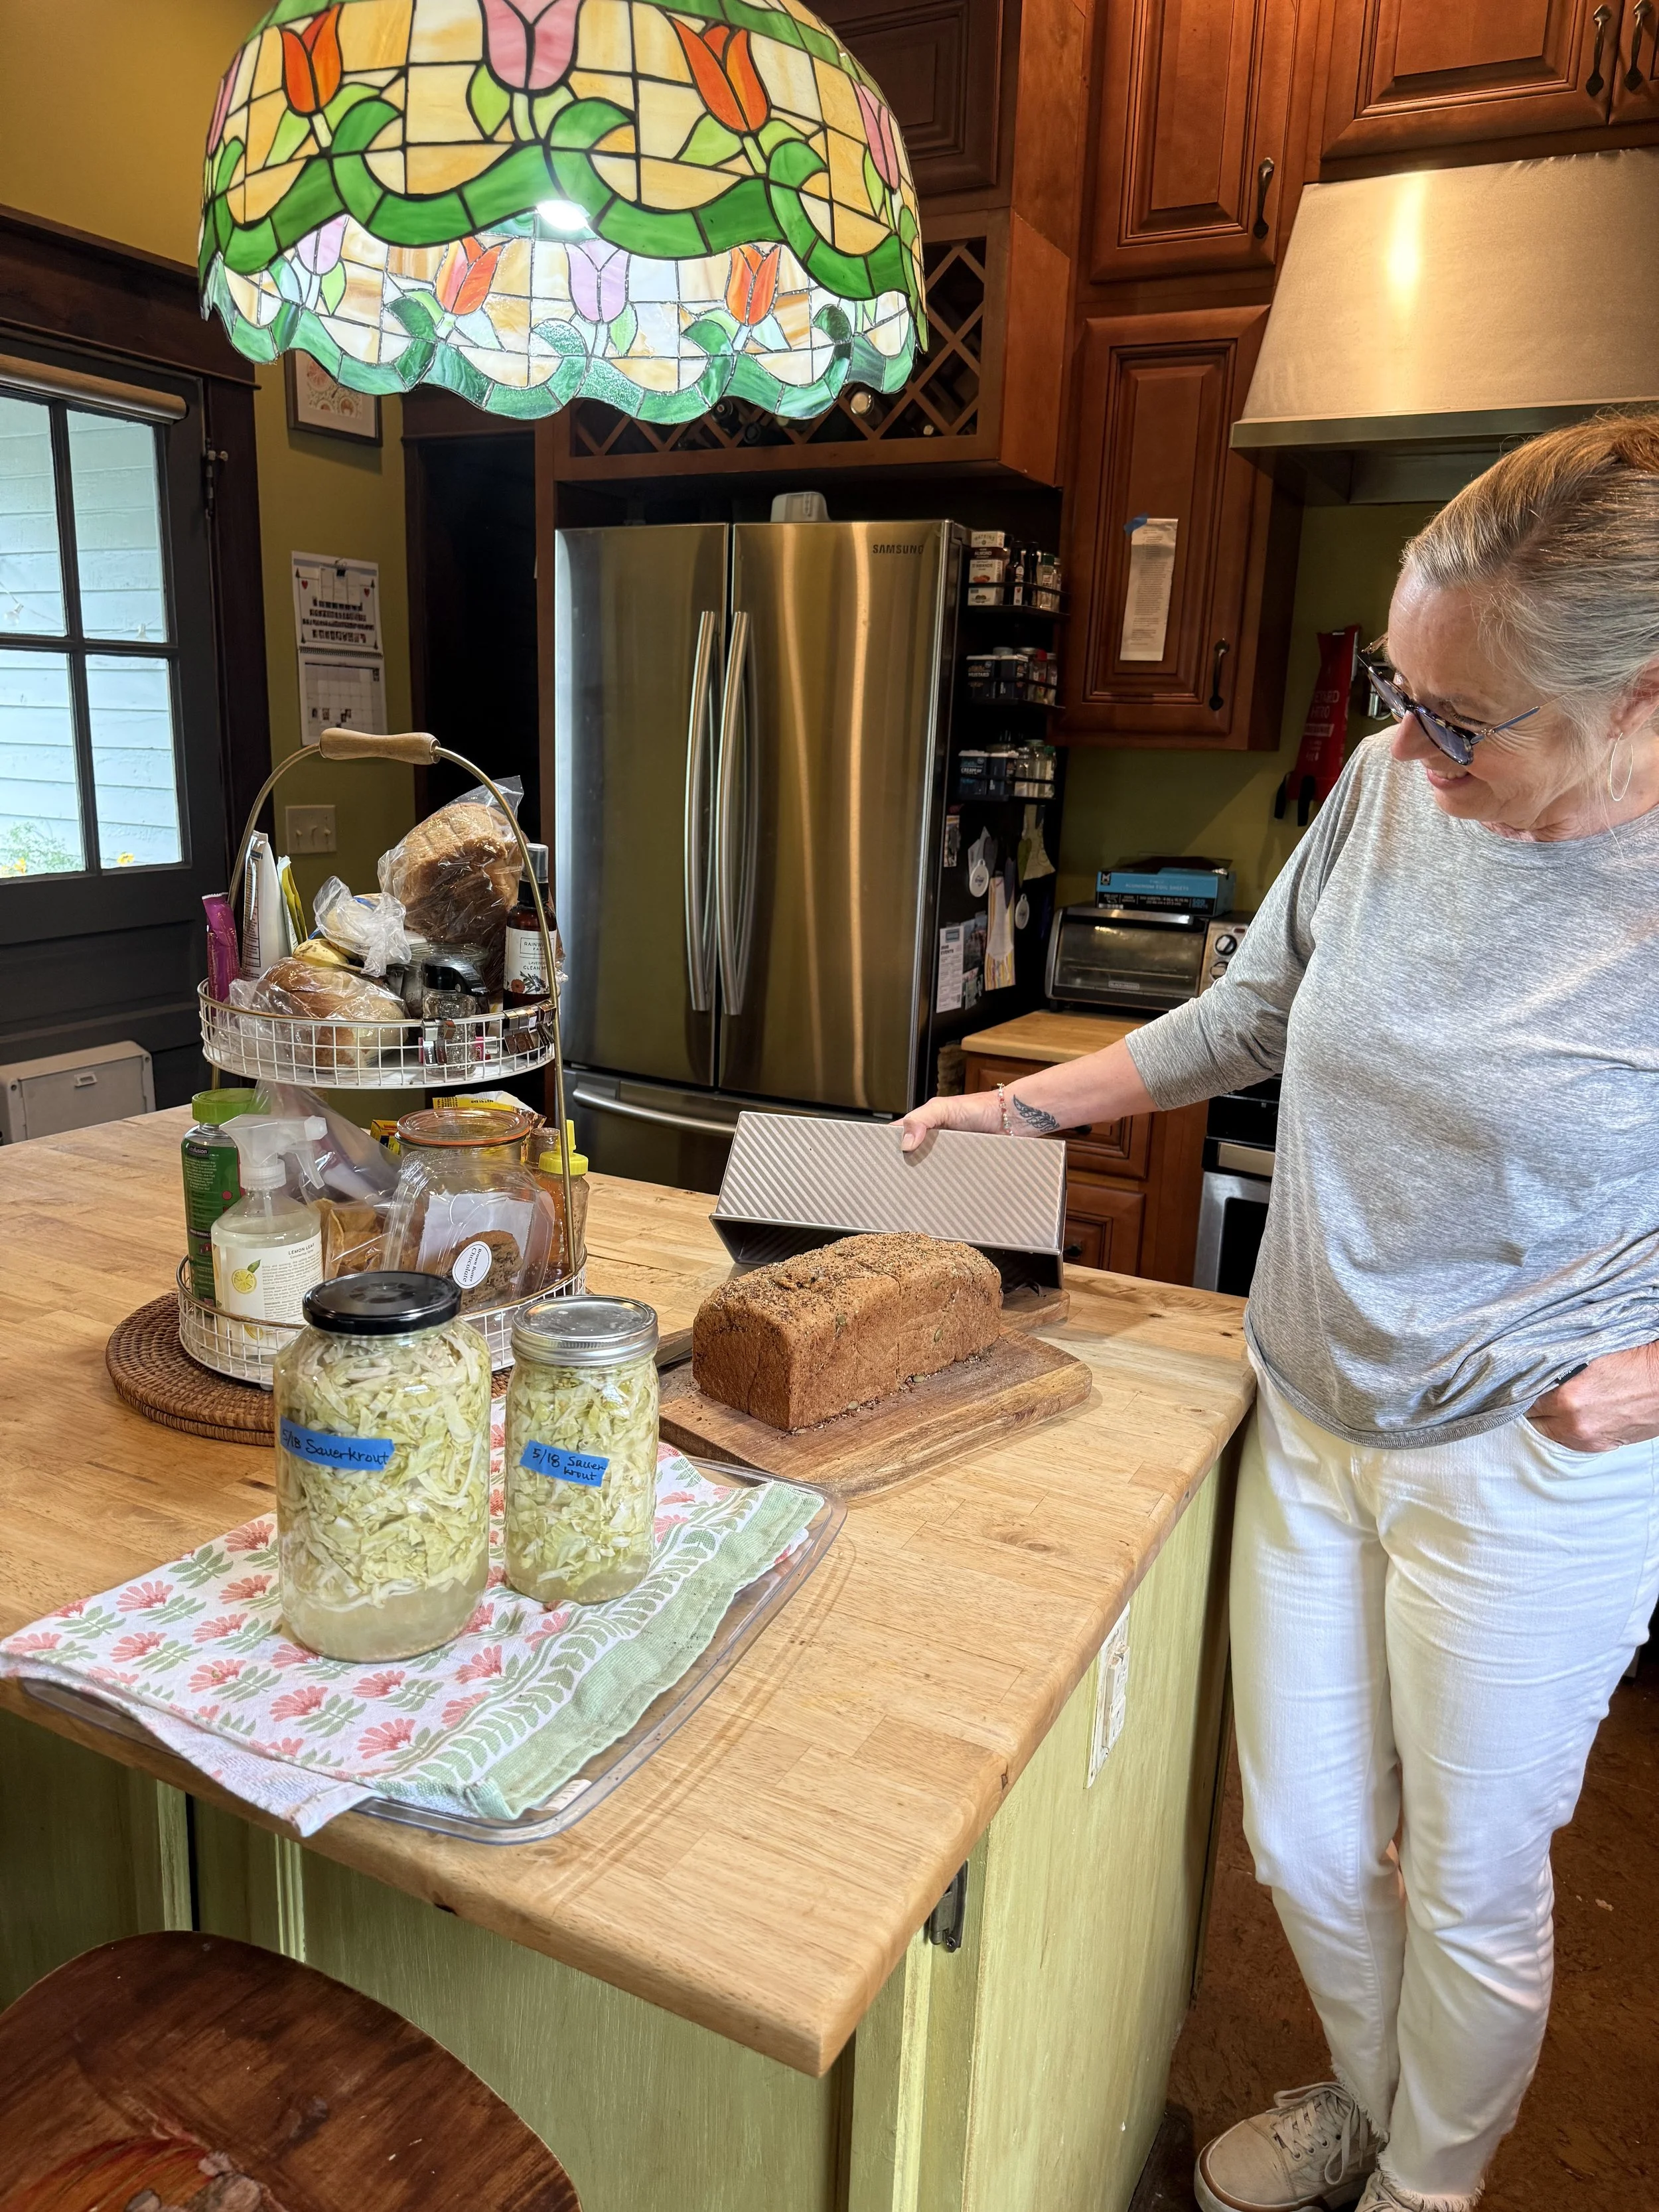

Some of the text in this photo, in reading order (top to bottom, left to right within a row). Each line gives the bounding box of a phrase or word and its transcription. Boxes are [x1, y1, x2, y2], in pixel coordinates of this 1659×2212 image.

[873, 544, 924, 554] SAMSUNG
[288, 1246, 305, 1255] LEMON
[473, 1248, 482, 1265] Brown
[463, 1248, 476, 1282] Chocolate
[305, 1438, 390, 1465] Sauerkrout
[532, 1448, 560, 1468] 5/18
[564, 1467, 597, 1481] krout
